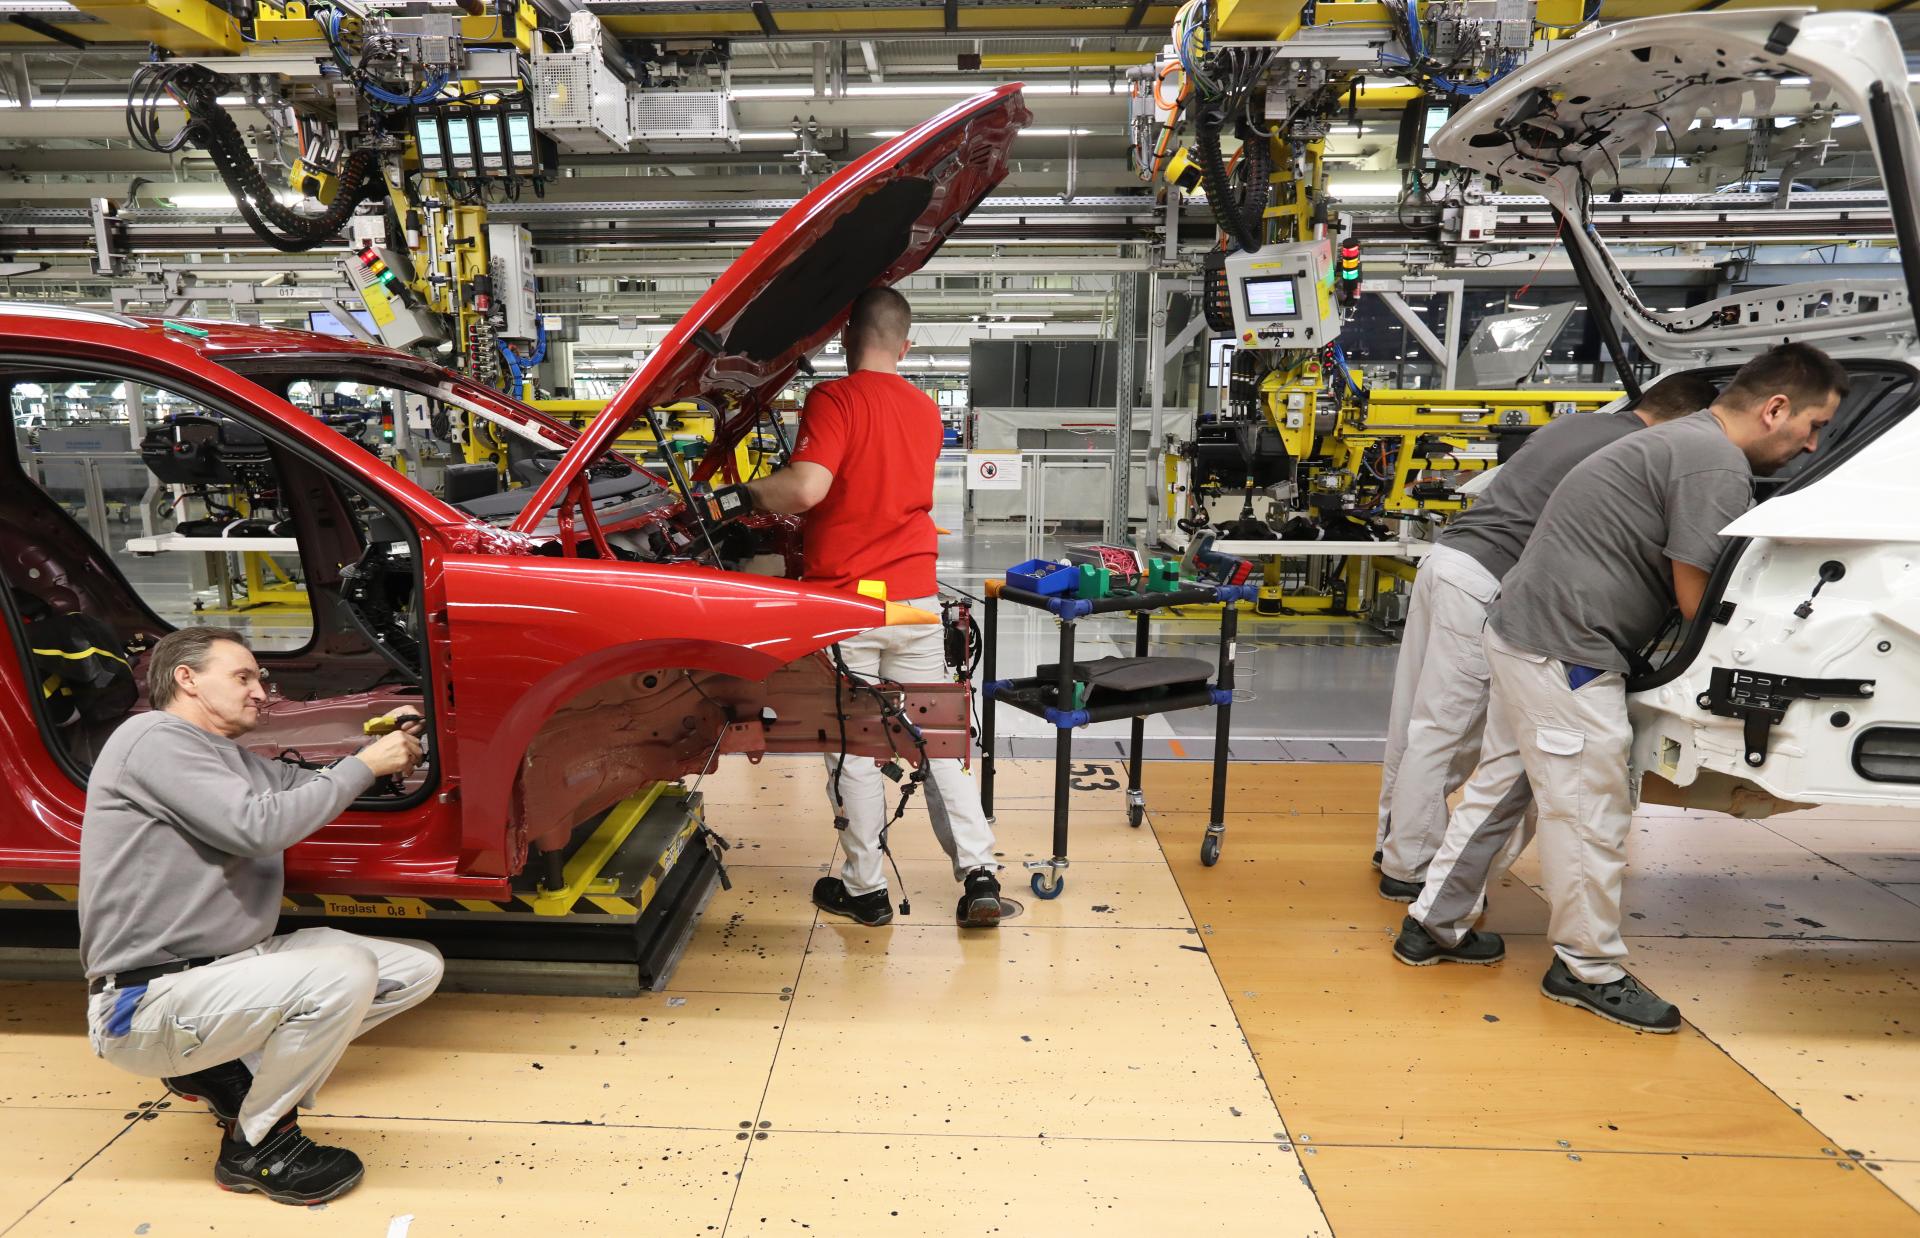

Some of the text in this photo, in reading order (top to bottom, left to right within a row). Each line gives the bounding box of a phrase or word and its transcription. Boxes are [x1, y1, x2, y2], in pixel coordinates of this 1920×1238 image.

[279, 288, 295, 297] 017
[1274, 337, 1281, 348] 2
[415, 404, 424, 421] 1
[1321, 406, 1329, 416] B
[1070, 763, 1120, 791] 53
[330, 902, 422, 917] Traglast 0,8 t
